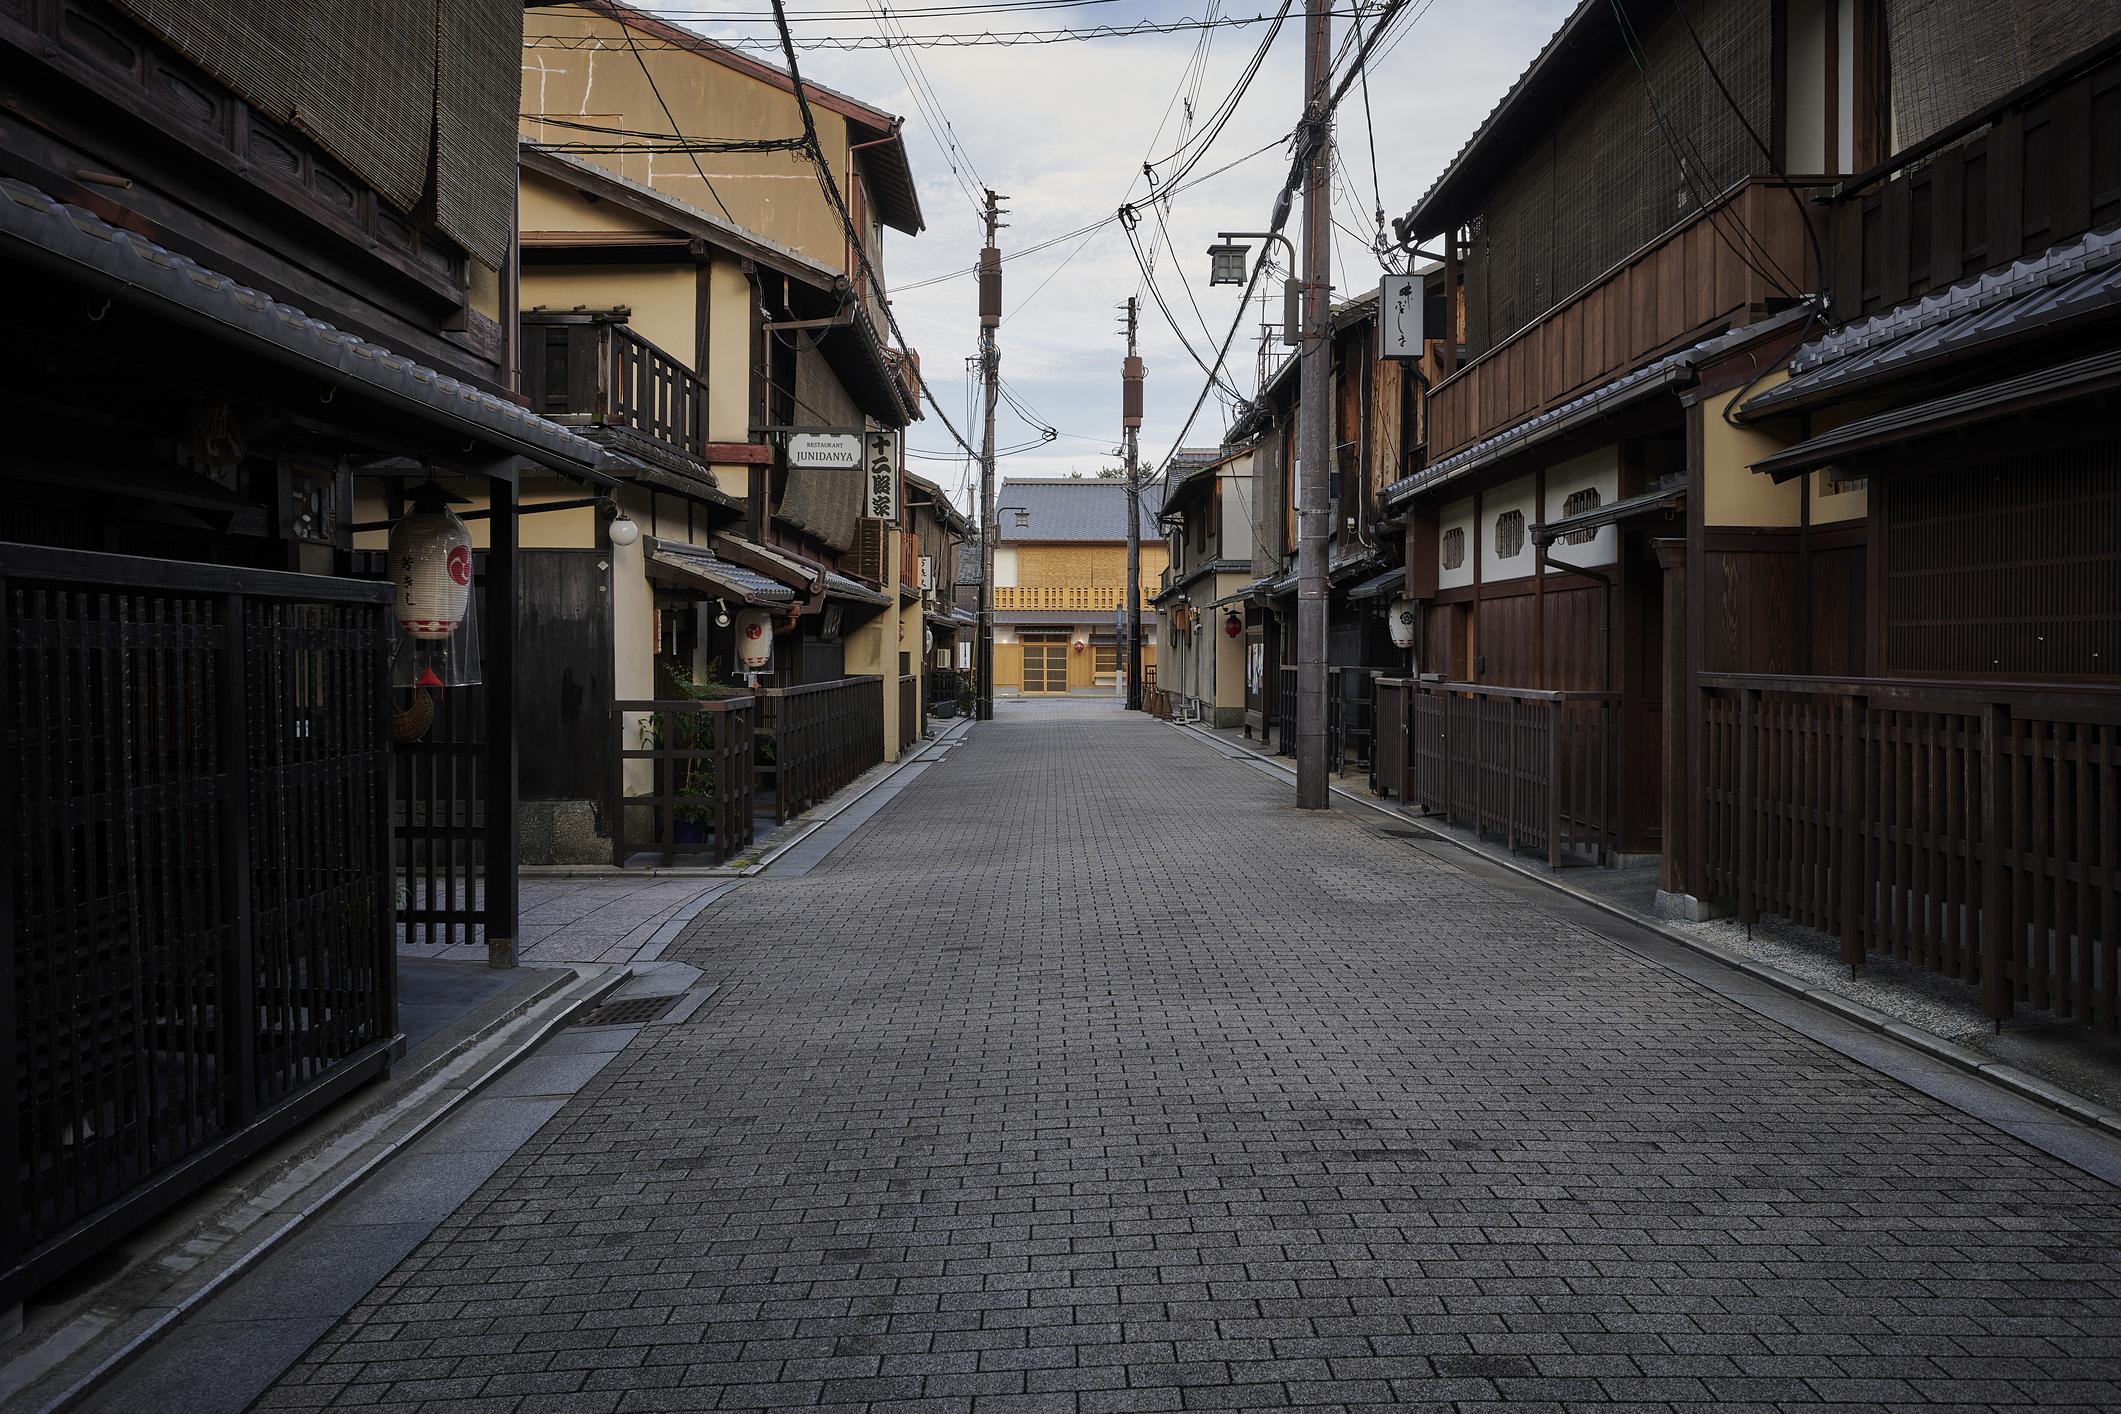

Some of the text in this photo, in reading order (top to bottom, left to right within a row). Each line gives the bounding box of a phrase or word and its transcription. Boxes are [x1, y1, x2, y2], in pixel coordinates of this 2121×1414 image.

[797, 451, 853, 462] JUNIDANYA
[871, 435, 891, 517] 十二段家
